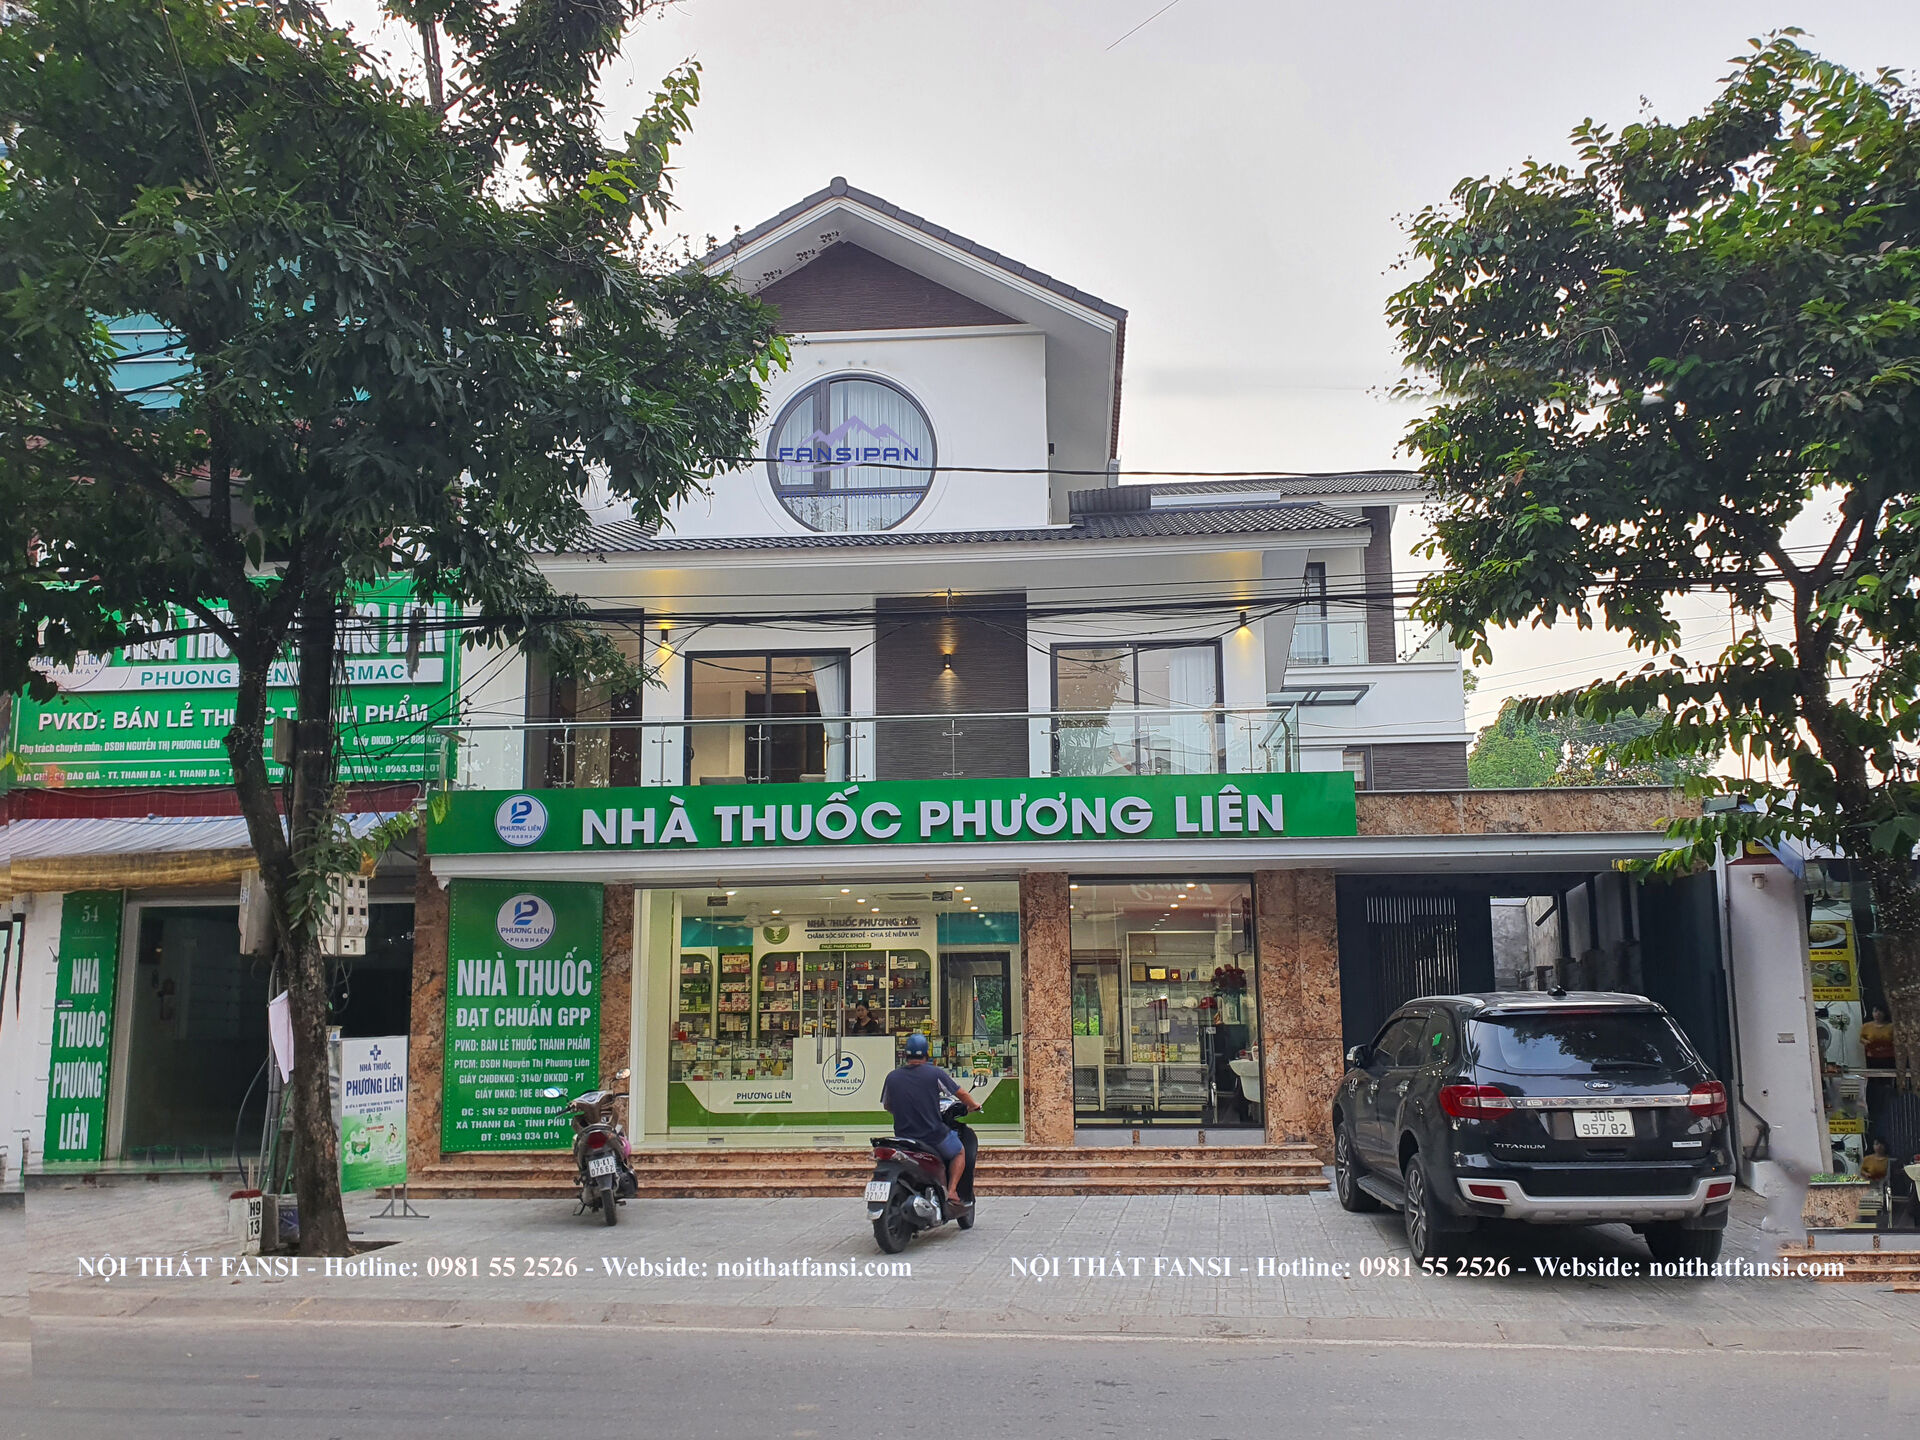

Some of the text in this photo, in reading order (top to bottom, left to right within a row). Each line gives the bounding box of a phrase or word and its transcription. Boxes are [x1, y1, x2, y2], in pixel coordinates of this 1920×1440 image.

[141, 669, 232, 686] PHUONG
[38, 711, 106, 731] PVKD:
[113, 706, 159, 730] BÁN
[166, 702, 194, 727] LẺ
[365, 694, 429, 723] PHẨM
[20, 744, 34, 755] Phụ
[35, 742, 54, 753] trách
[56, 742, 83, 754] chuyên
[172, 738, 202, 750] PHƯƠNG
[203, 737, 220, 749] LIÊN
[121, 770, 148, 780] THANH
[150, 770, 161, 779] BA
[180, 768, 207, 779] THANH
[209, 768, 220, 778] BA
[582, 784, 1284, 845] NHÀ THUỐC PHƯƠNG LIÊN
[500, 925, 550, 934] PHƯƠNG LIÊN
[70, 952, 100, 994] NHÀ
[456, 946, 592, 996] NHÀ THUỐC
[59, 998, 106, 1049] THUỐC
[456, 1000, 591, 1031] ĐẠT CHUẨN GPP
[455, 1039, 479, 1051] PVKD:
[481, 1036, 498, 1051] BÁN
[500, 1035, 509, 1051] LẺ
[511, 1034, 537, 1051] THUỐC
[567, 1032, 591, 1050] PHẨM
[359, 1061, 391, 1073] NHÀ THUỐC
[454, 1059, 478, 1069] PTCM:
[533, 1058, 543, 1069] Thị
[574, 1057, 590, 1067] Liên
[52, 1056, 103, 1099] PHƯƠNG
[345, 1073, 404, 1097] PHƯƠNG LIÊN
[575, 1072, 584, 1081] PT
[736, 1090, 792, 1100] PHƯƠNG LIÊN
[482, 1108, 495, 1116] SN
[497, 1107, 509, 1116] 52
[59, 1106, 89, 1150] LIÊN
[471, 1120, 501, 1129] THANH
[503, 1119, 516, 1128] BA
[1582, 1123, 1628, 1136] 957.82
[1494, 1142, 1546, 1150] TITANIUM
[249, 1201, 261, 1217] H9
[249, 1219, 260, 1236] 13
